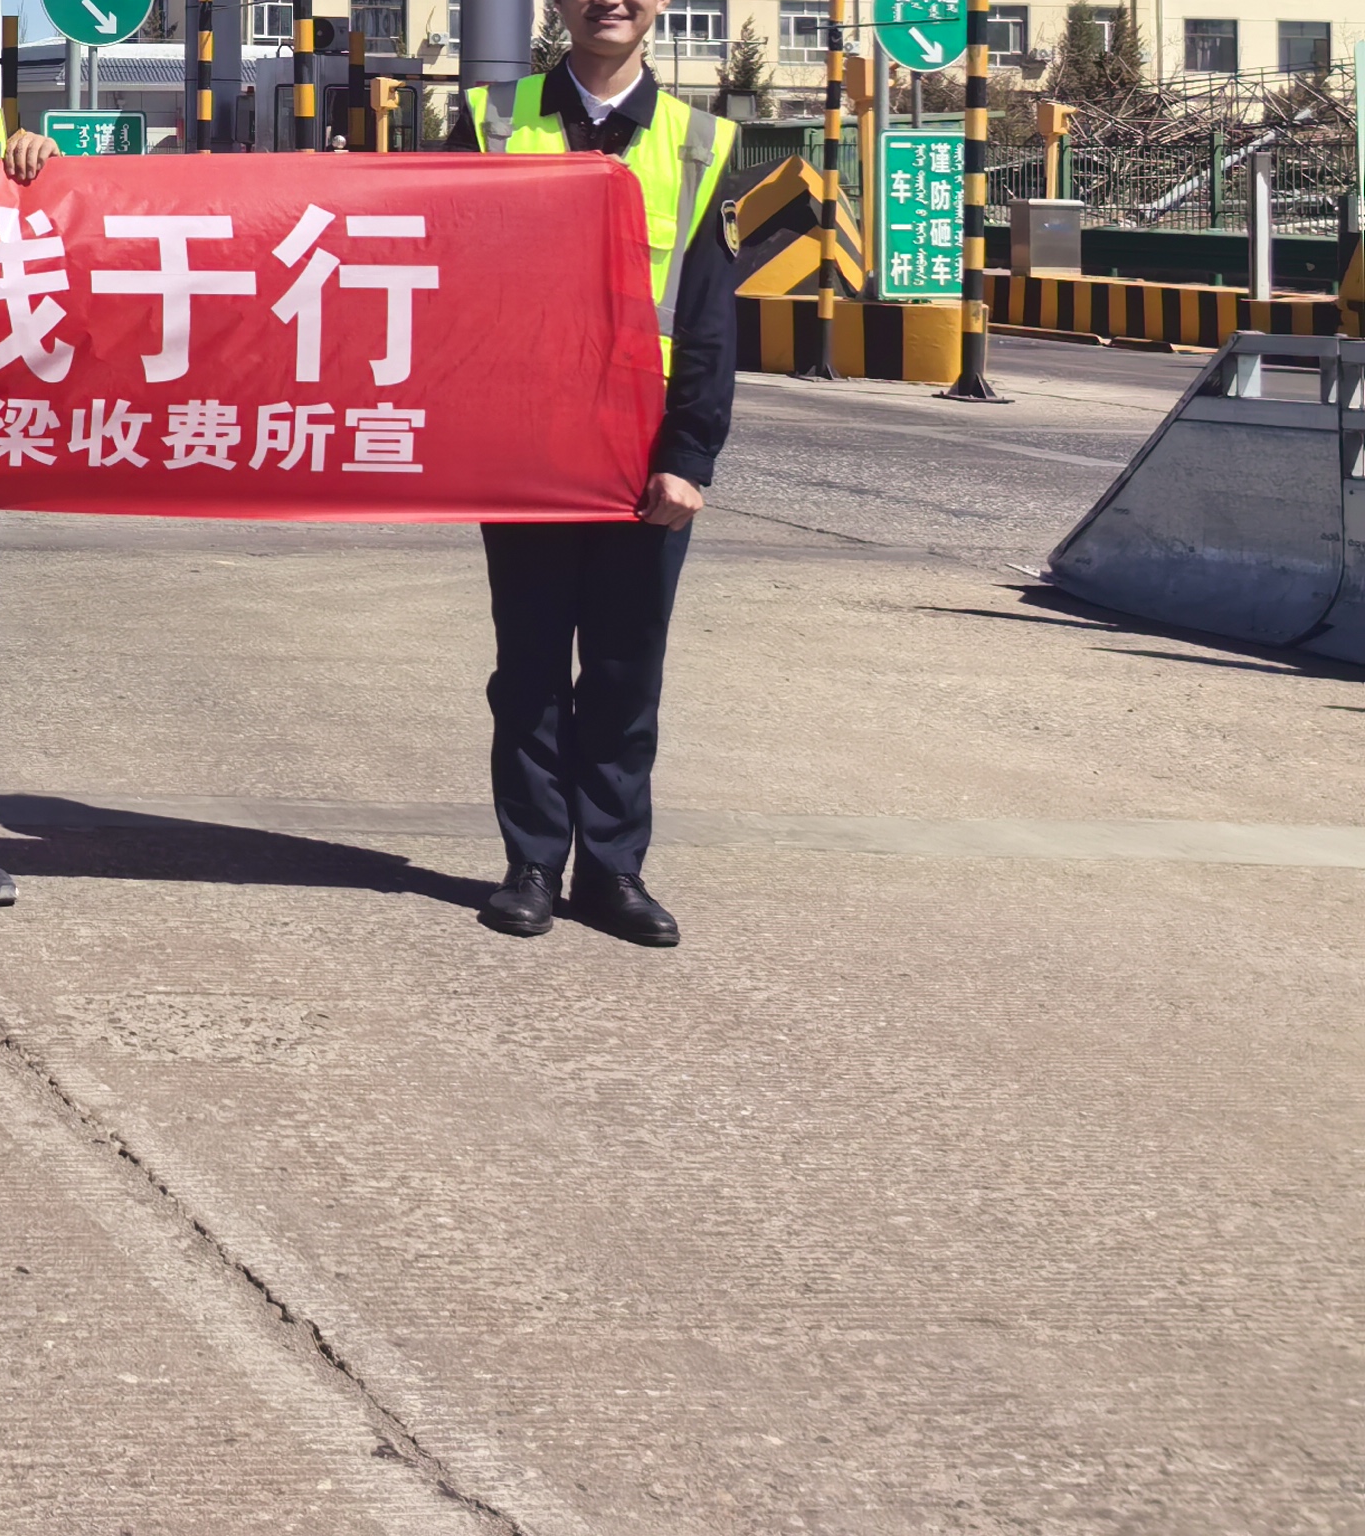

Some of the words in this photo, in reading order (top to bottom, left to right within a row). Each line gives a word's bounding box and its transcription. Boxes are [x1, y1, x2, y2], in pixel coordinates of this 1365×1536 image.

[890, 142, 912, 286] 一车一杆
[929, 142, 951, 286] 谨防砸车
